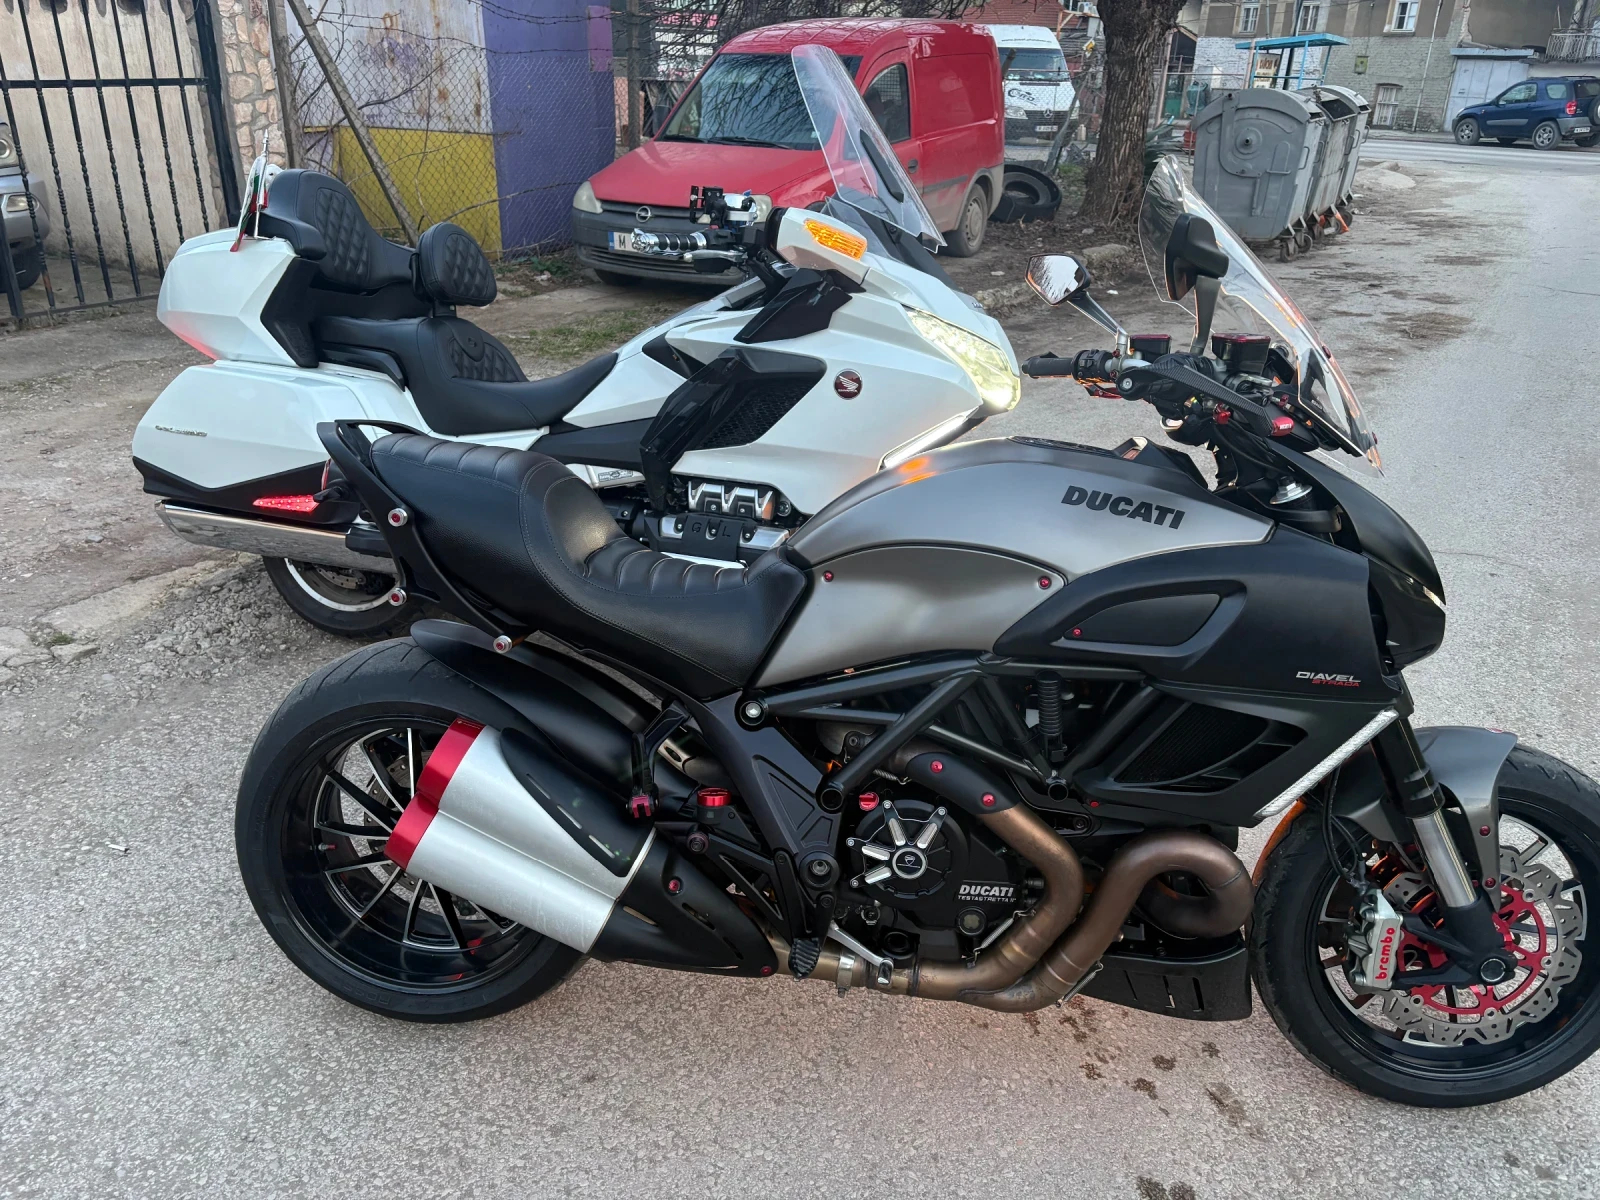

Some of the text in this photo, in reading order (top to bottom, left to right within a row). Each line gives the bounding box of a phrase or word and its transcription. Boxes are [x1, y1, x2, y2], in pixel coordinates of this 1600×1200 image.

[1061, 485, 1185, 529] DUCATI
[1295, 671, 1362, 683] DIAVEL
[959, 884, 1014, 896] DUCATI
[1375, 927, 1395, 980] brembo
